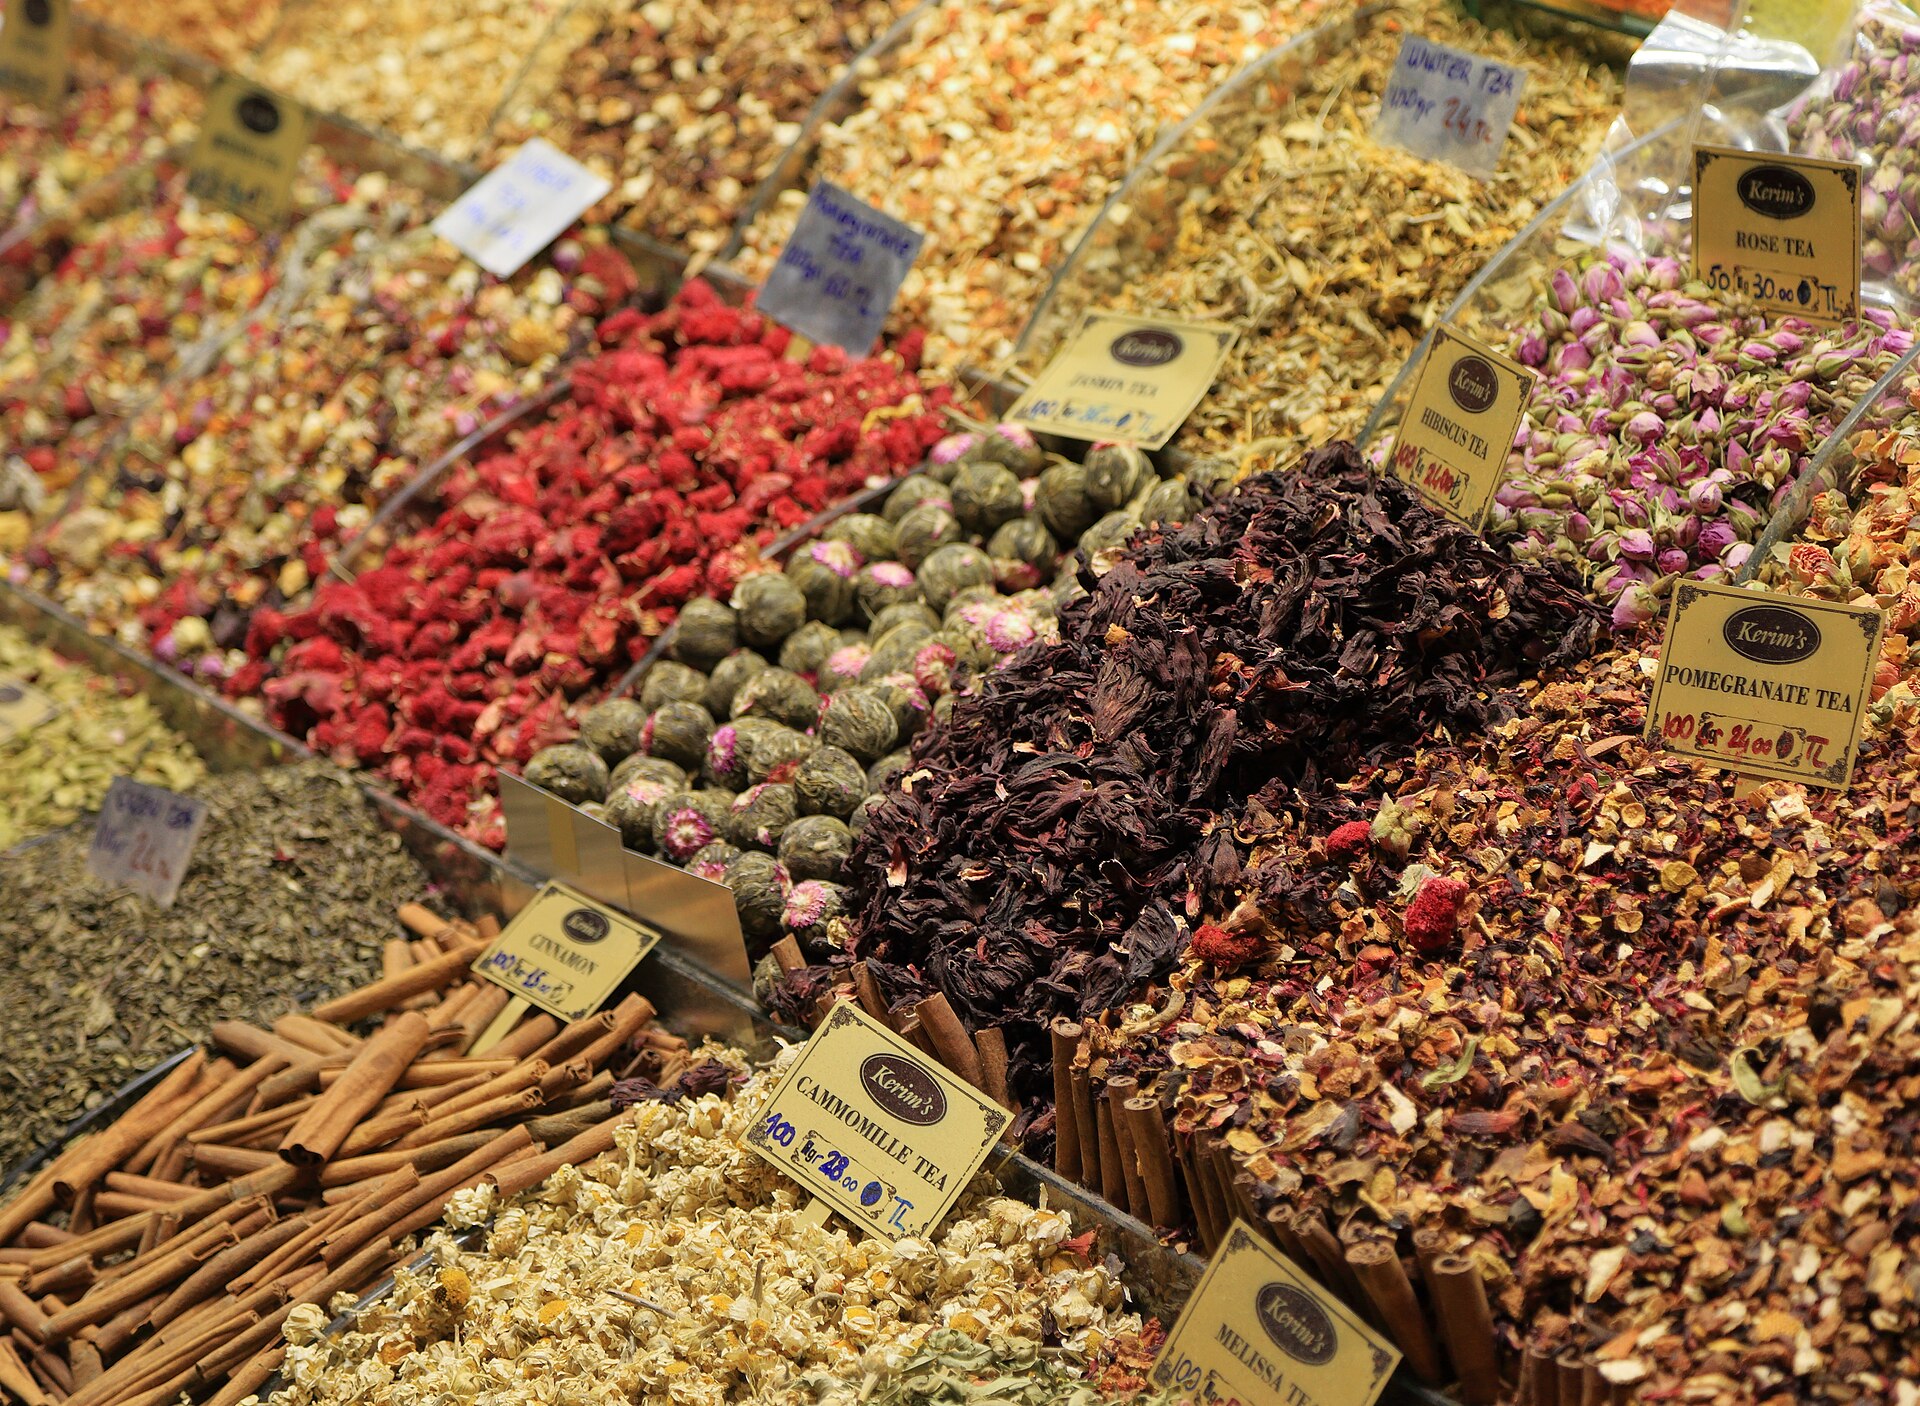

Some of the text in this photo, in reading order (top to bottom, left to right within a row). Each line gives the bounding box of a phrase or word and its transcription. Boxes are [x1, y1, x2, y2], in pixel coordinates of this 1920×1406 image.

[1749, 178, 1805, 206] Kerim's
[1736, 230, 1815, 259] ROSE TEA
[1707, 264, 1730, 291] 50
[1454, 367, 1491, 403] Kerim's
[1421, 407, 1490, 461] HIBISCUS TEA
[1735, 620, 1808, 651] Kerim's
[1665, 664, 1852, 713] POMEGRANATE TEA
[1662, 711, 1695, 740] 100
[1804, 735, 1830, 769] TL
[527, 933, 600, 976] CINNAMON
[869, 1064, 934, 1116] Kerim's
[766, 1111, 797, 1148] 100
[796, 1075, 950, 1193] CAMMOMILLE TEA
[1265, 1295, 1327, 1355] Kerim's
[1214, 1322, 1320, 1406] MELISSA TE
